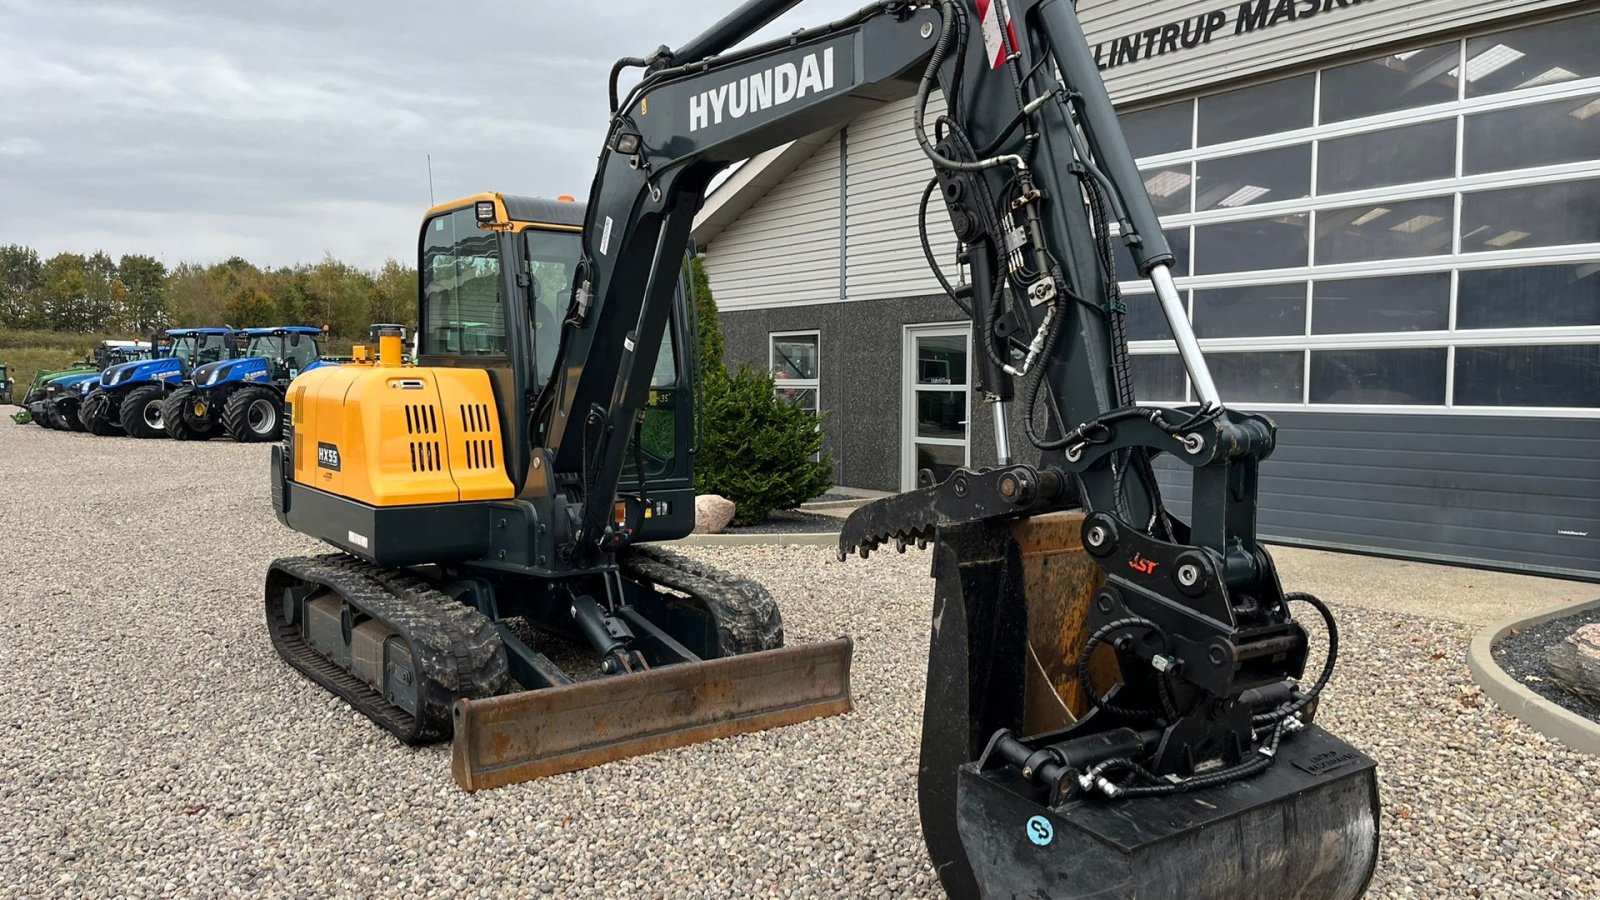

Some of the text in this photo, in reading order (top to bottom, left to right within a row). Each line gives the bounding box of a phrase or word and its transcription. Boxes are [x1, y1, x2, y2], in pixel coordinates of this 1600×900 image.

[1094, 10, 1226, 71] LINTRUP
[689, 46, 834, 132] HYUNDAI
[318, 447, 338, 464] HX55
